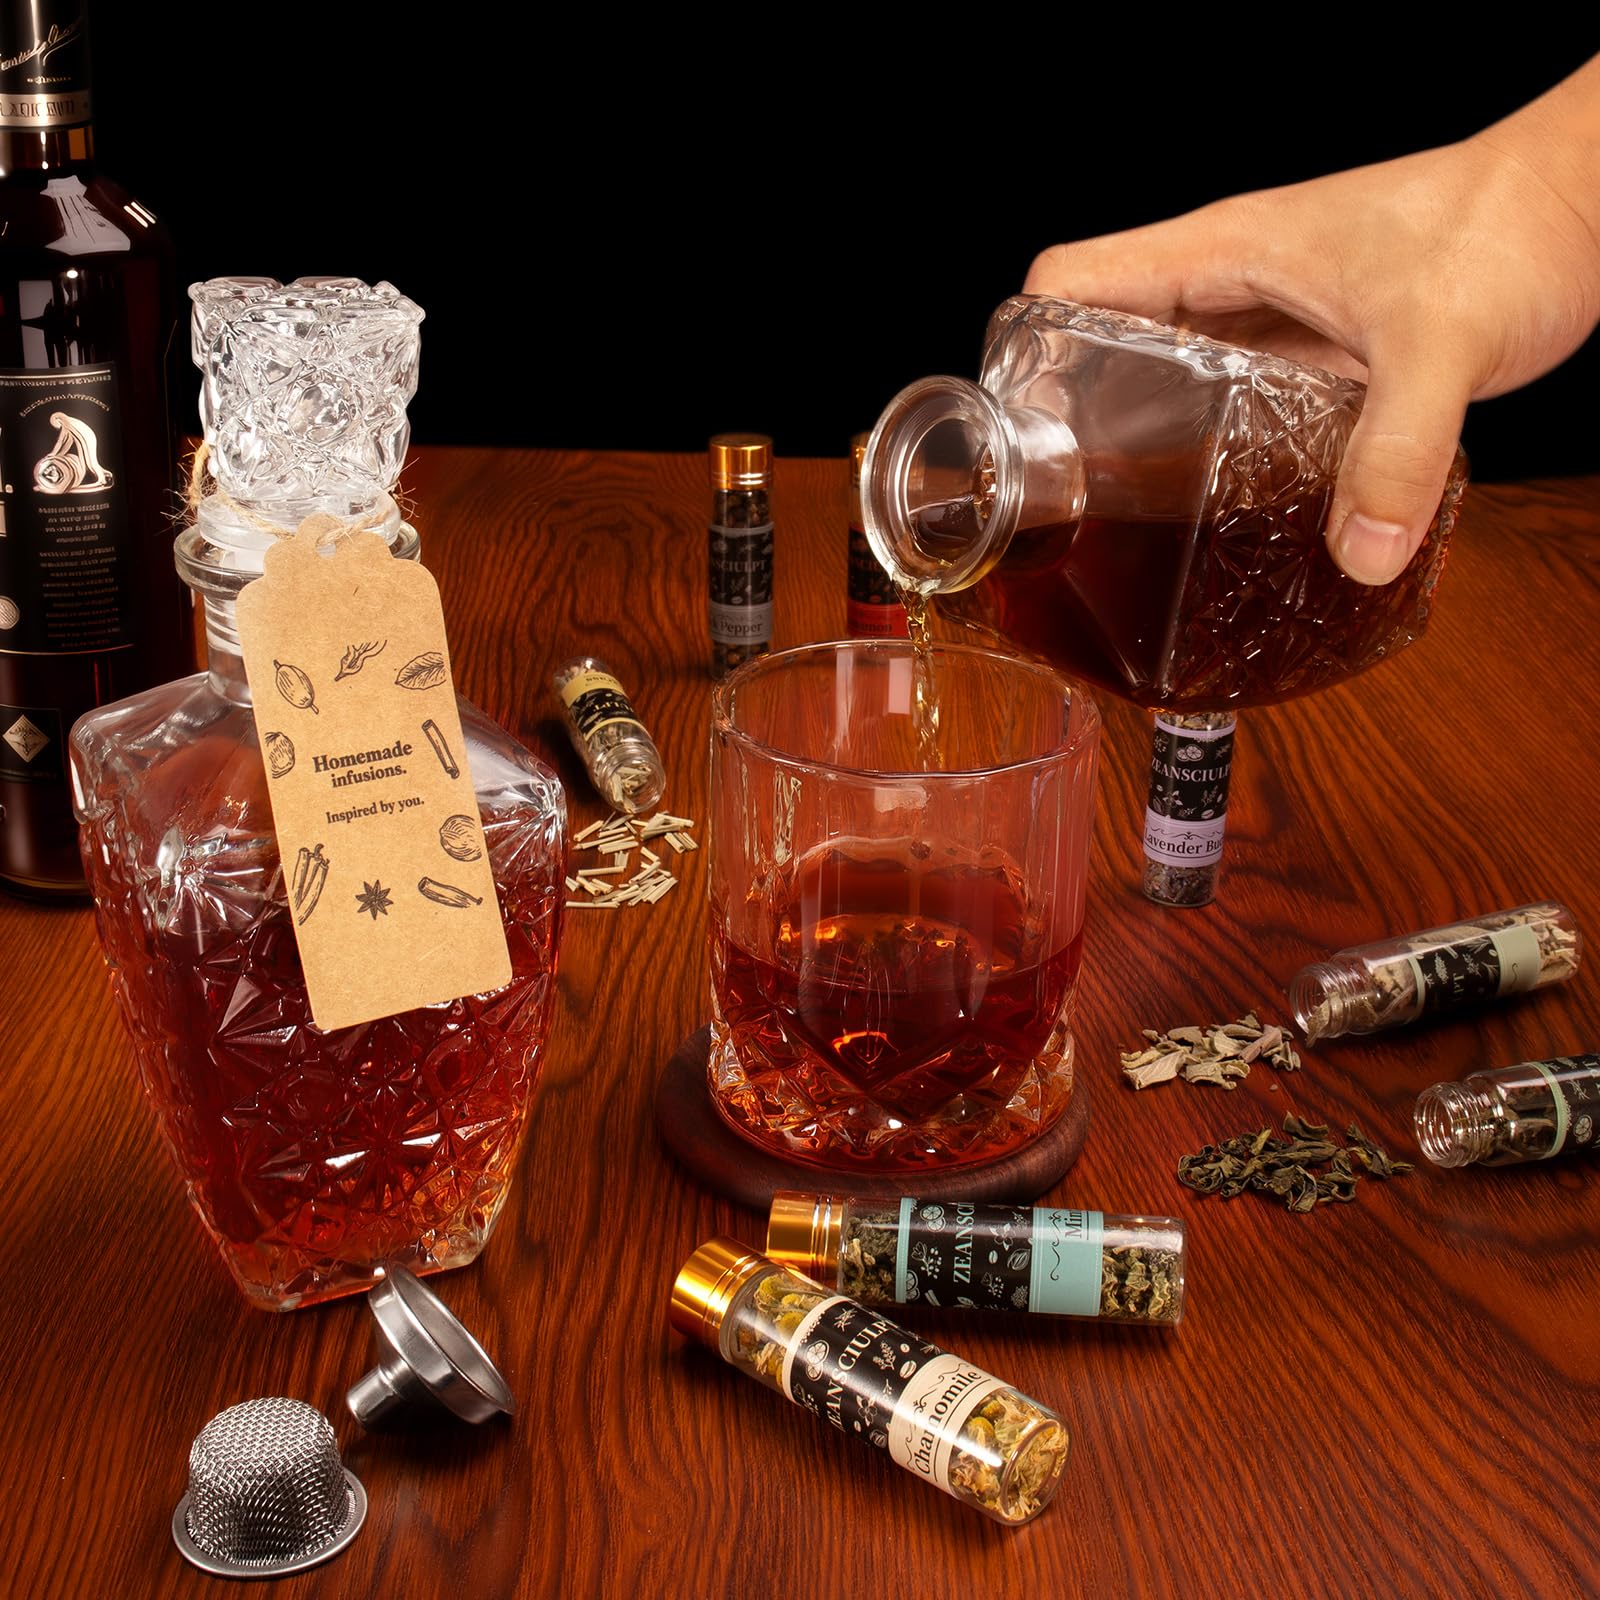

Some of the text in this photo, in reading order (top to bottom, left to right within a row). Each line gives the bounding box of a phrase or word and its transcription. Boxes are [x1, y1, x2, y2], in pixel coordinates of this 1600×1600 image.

[721, 621, 763, 636] Pepper
[312, 740, 413, 773] Homemade
[331, 763, 407, 788] infusions.
[325, 796, 425, 824] Inspired by you.
